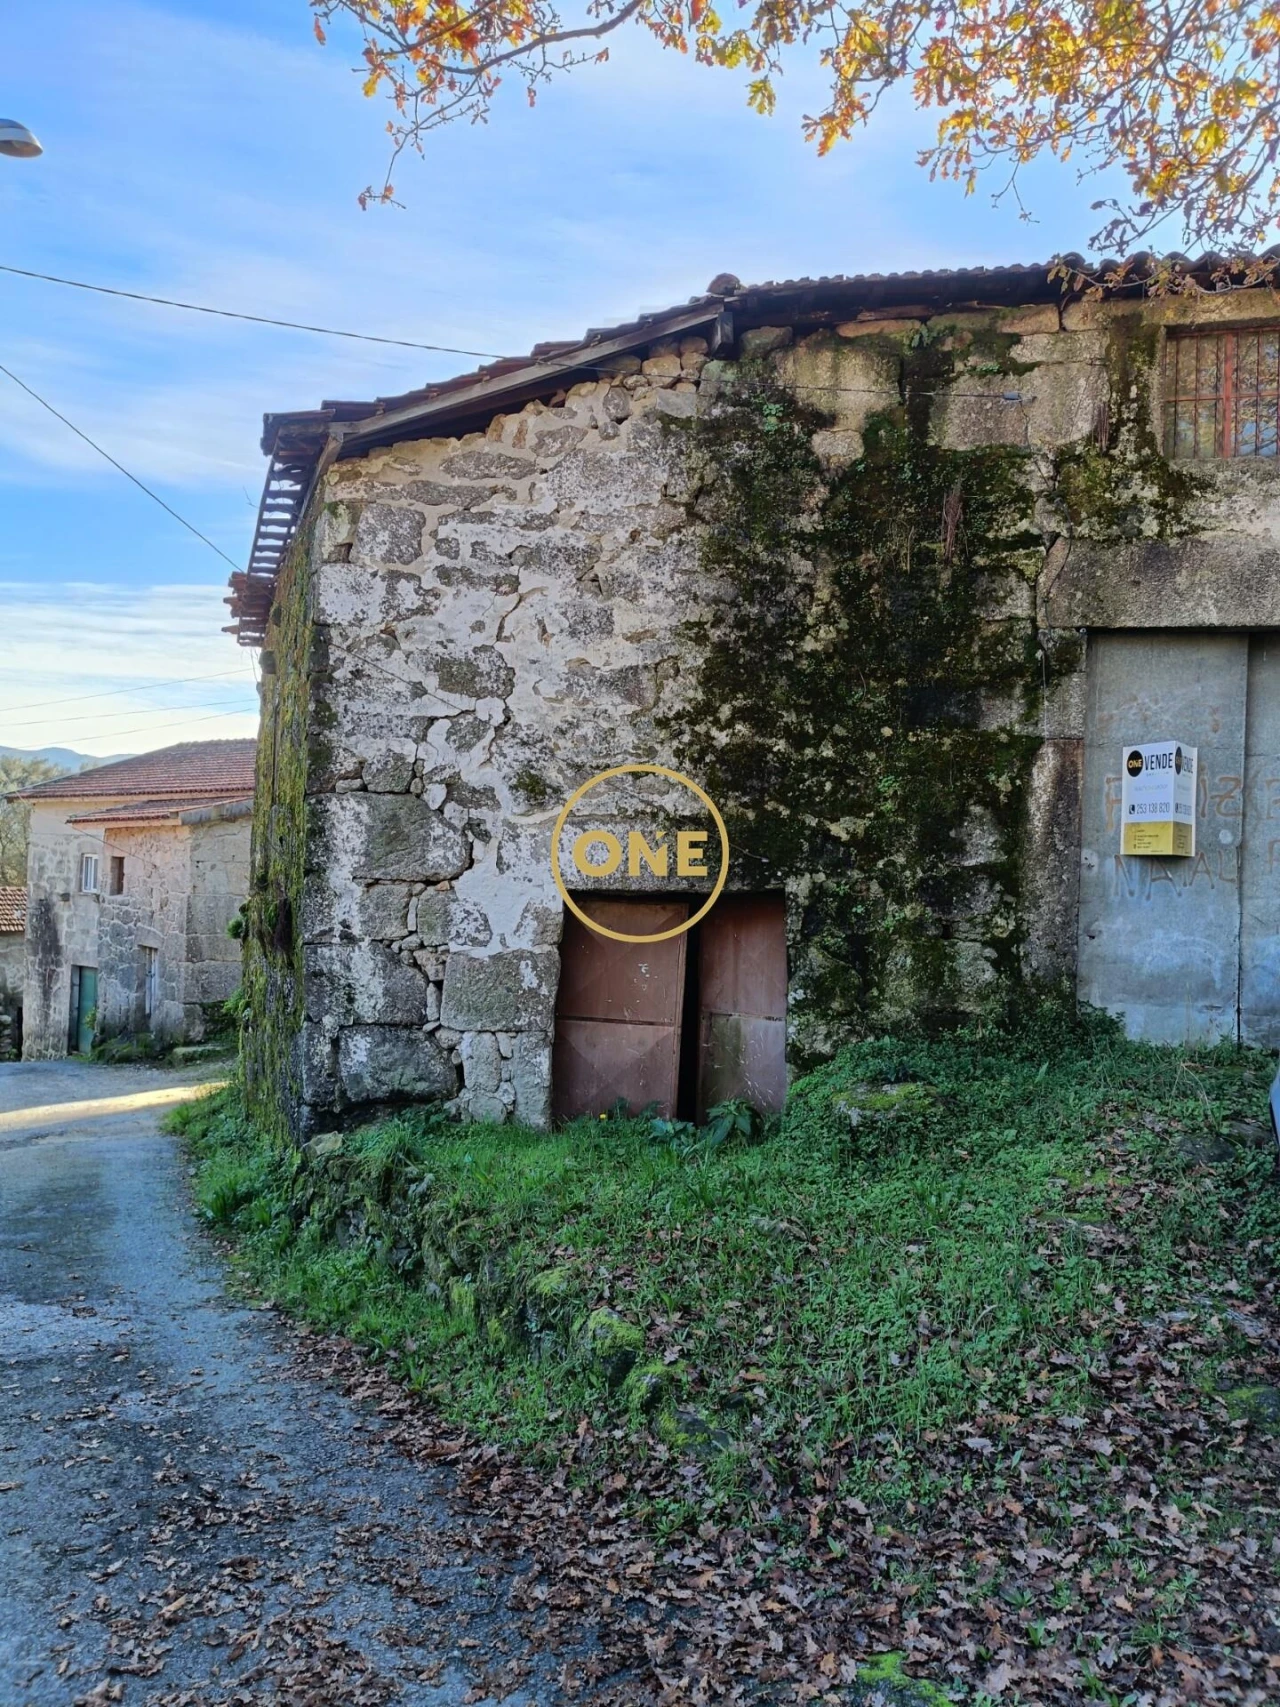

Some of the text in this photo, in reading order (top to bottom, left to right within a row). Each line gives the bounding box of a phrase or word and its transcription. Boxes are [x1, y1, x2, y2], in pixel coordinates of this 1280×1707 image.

[1128, 759, 1142, 769] ONE
[1144, 752, 1174, 771] VENDE
[1136, 803, 1147, 814] 253
[1159, 802, 1170, 813] 820
